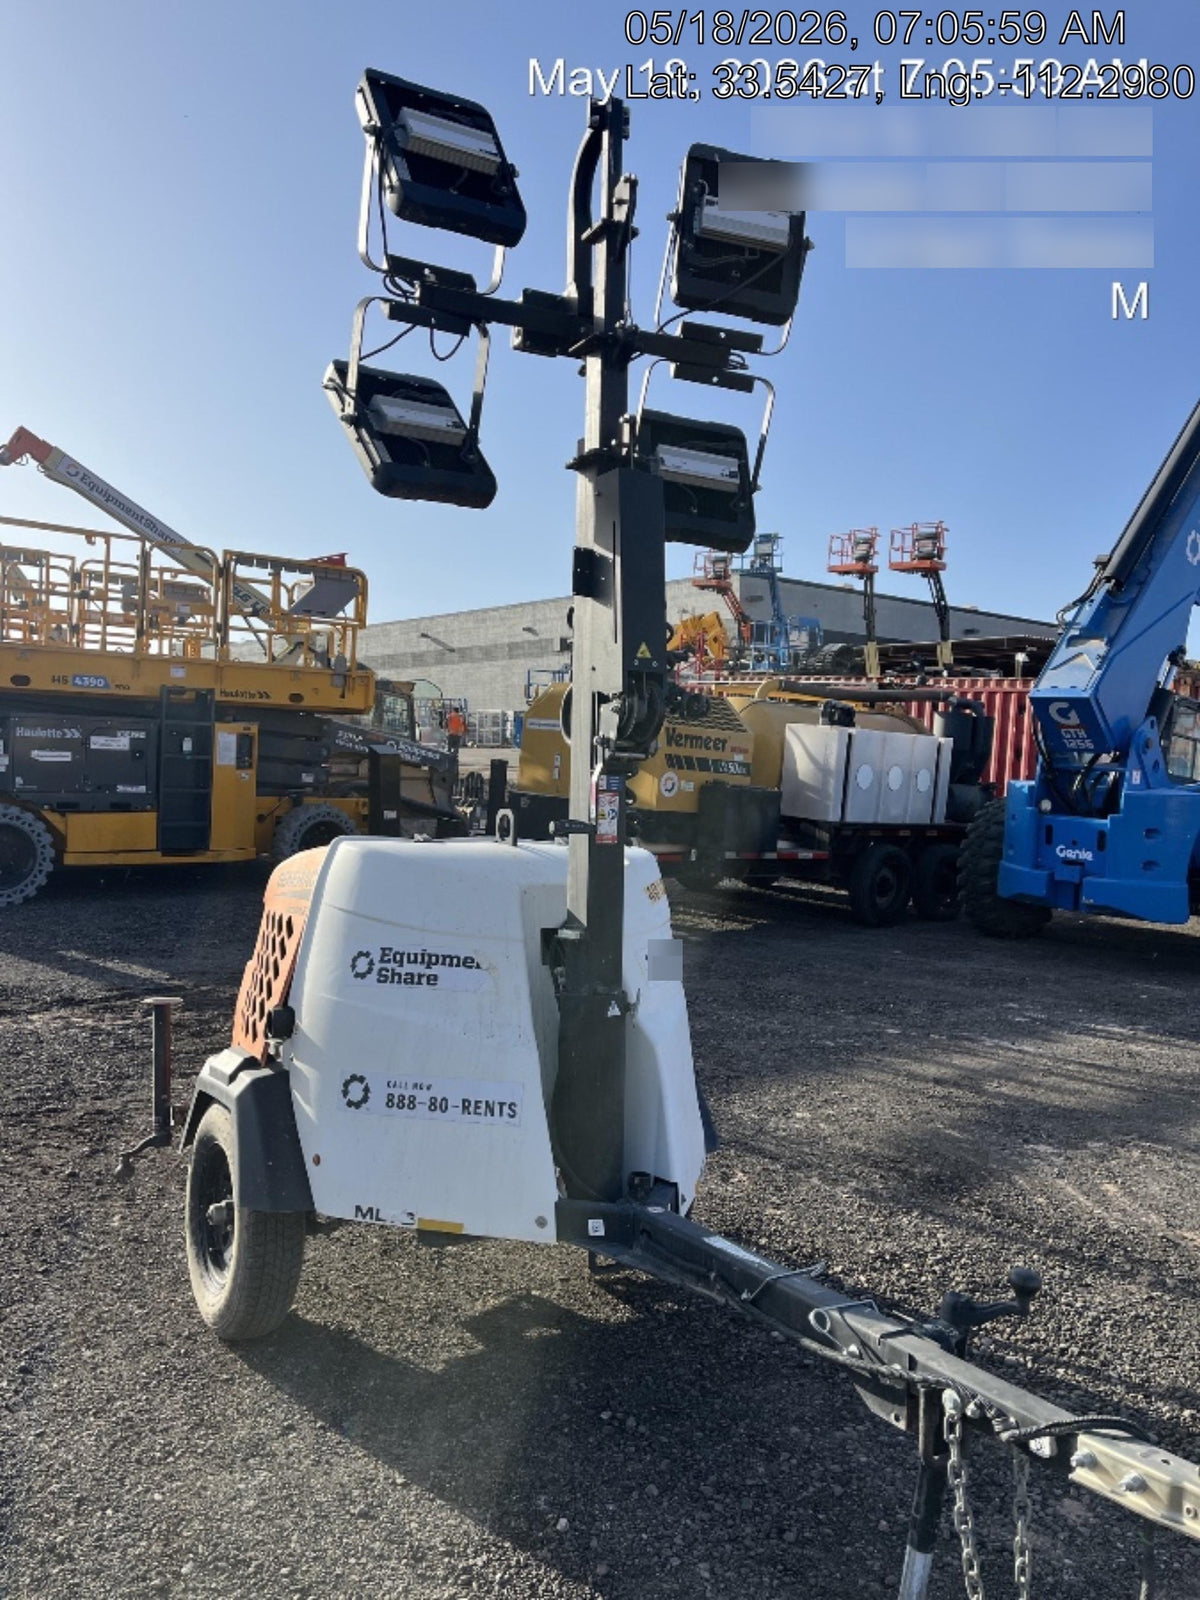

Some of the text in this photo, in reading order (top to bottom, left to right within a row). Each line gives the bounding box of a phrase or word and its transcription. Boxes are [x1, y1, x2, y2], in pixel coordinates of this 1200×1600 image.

[664, 726, 728, 752] Vermeer
[1055, 844, 1093, 861] Genie
[378, 947, 482, 970] Equipme
[376, 967, 439, 986] Share
[385, 1093, 518, 1119] 888-80-RENTS
